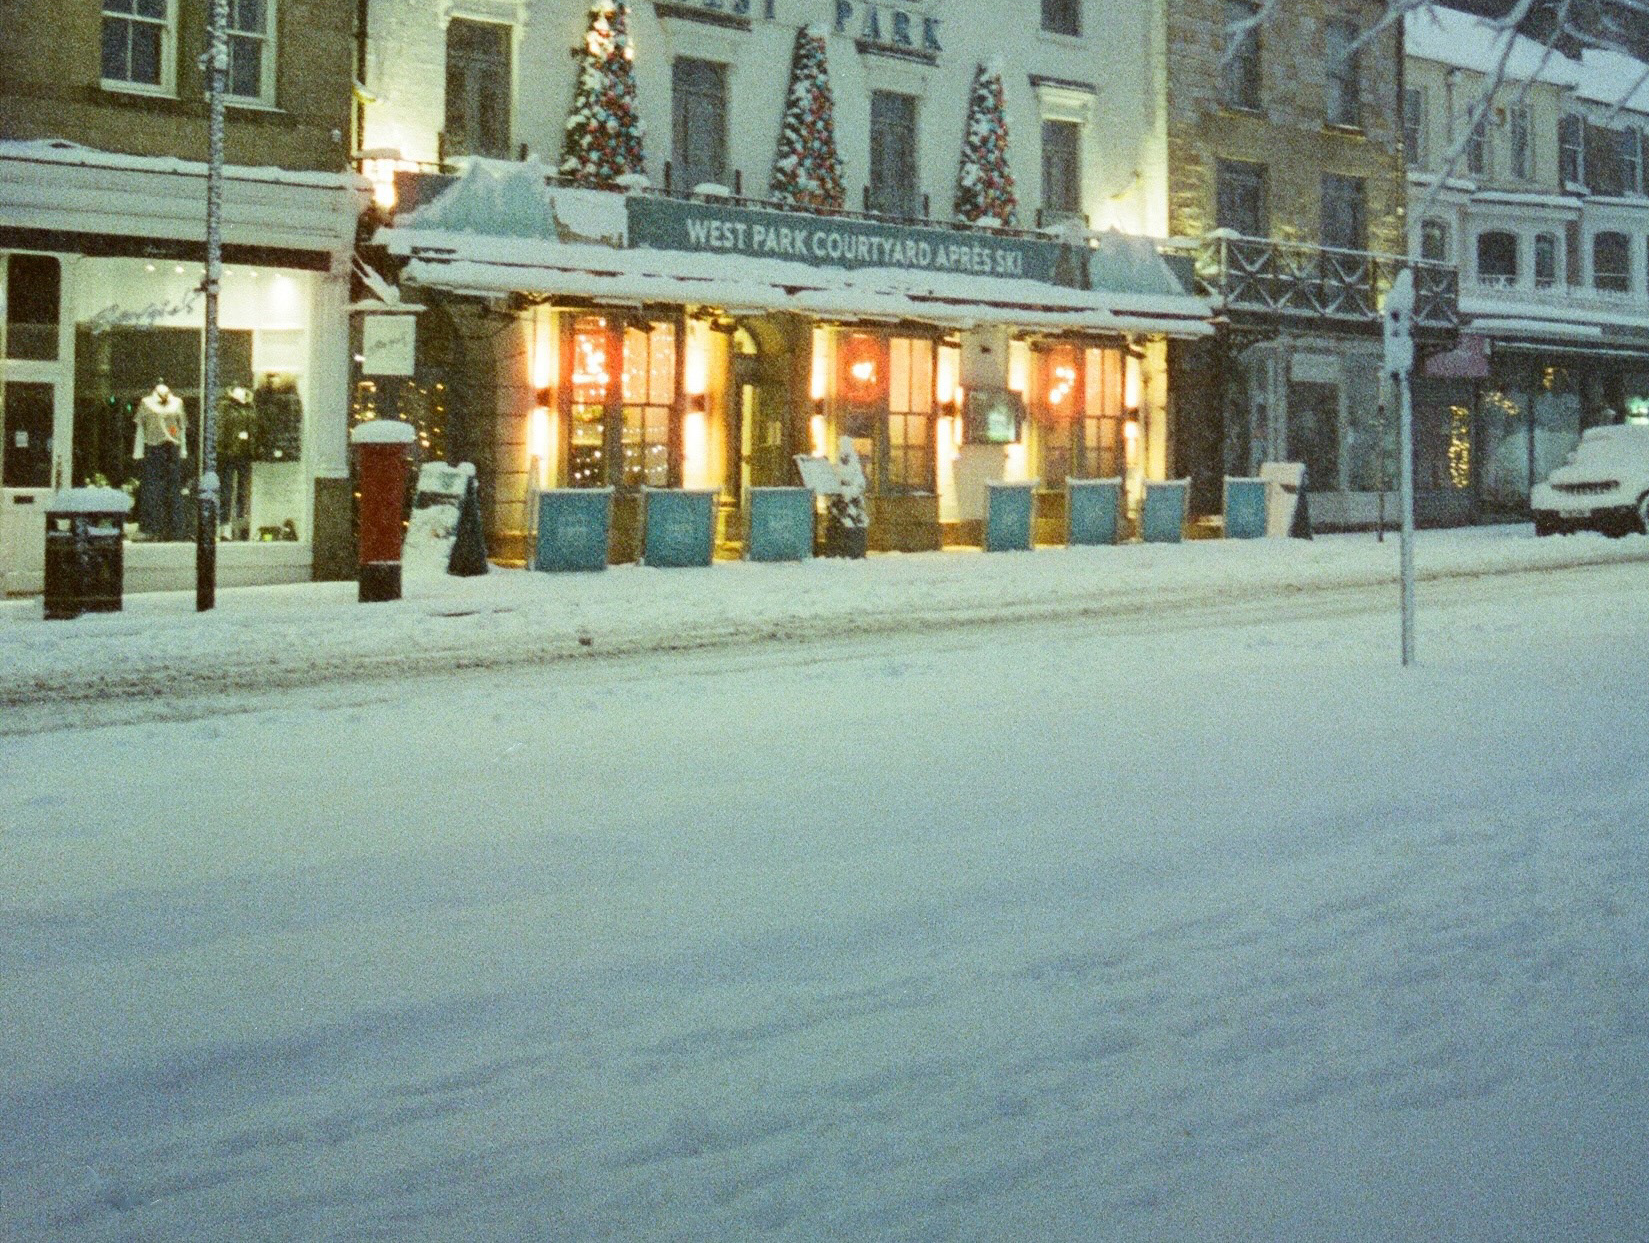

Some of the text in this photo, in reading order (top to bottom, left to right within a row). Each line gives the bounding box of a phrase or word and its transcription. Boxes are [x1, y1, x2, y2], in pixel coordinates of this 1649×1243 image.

[686, 218, 747, 249] WEST
[752, 224, 809, 256] PARK
[812, 231, 932, 266] COURTYARD
[994, 249, 1023, 274] SKI
